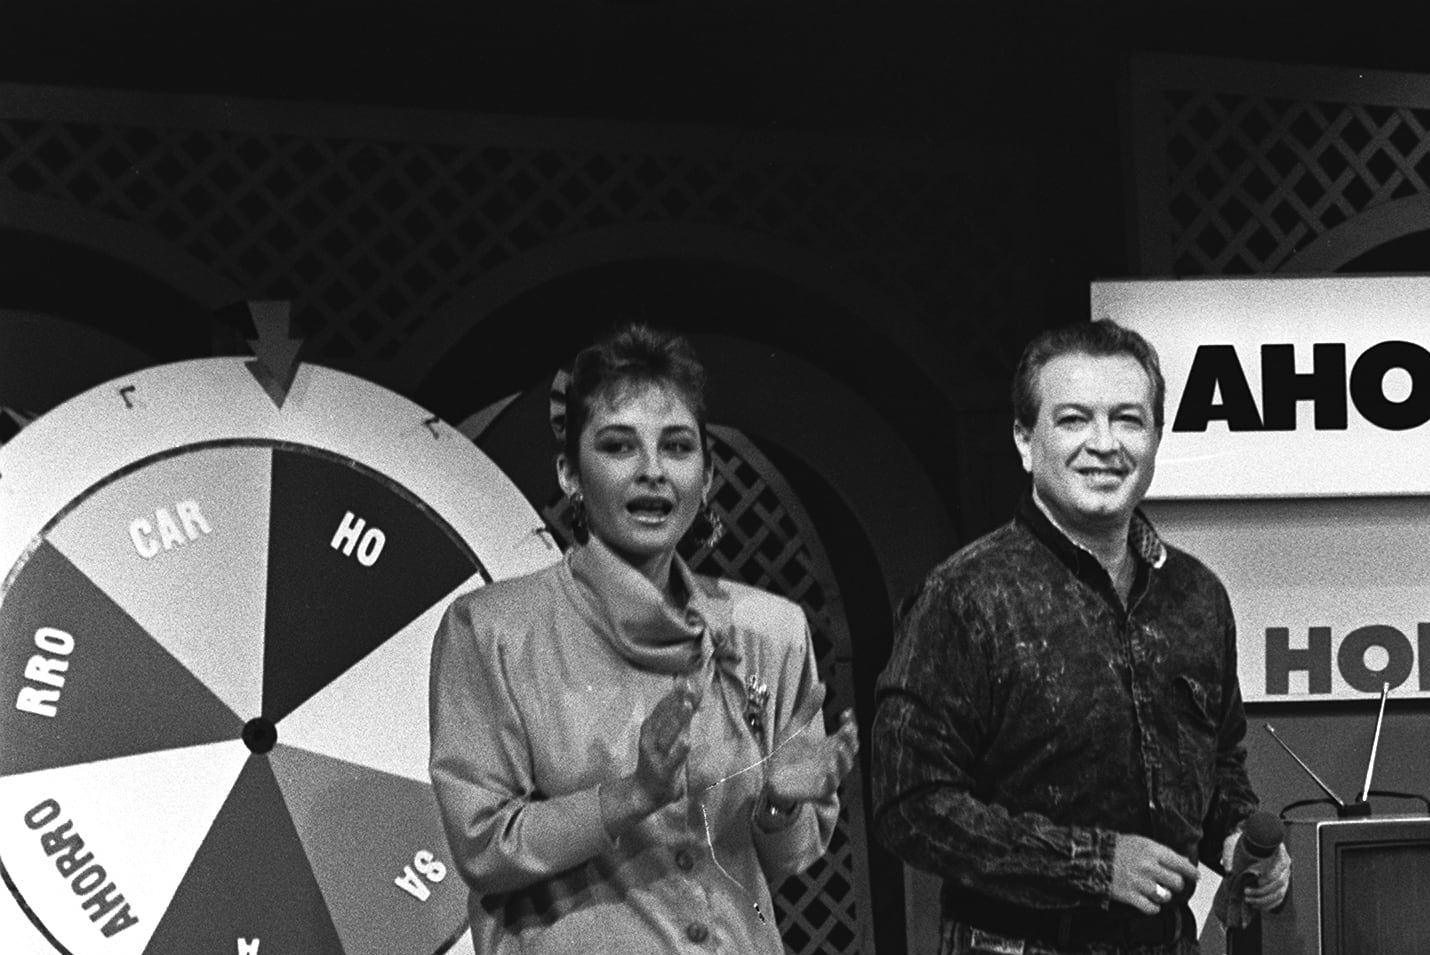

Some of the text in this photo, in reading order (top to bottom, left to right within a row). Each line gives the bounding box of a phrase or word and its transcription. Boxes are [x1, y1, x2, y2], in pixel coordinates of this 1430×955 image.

[128, 498, 212, 559] CAR
[330, 510, 386, 567] HO
[15, 626, 75, 718] RRO
[24, 798, 140, 938] AHORRO
[394, 850, 447, 902] SA
